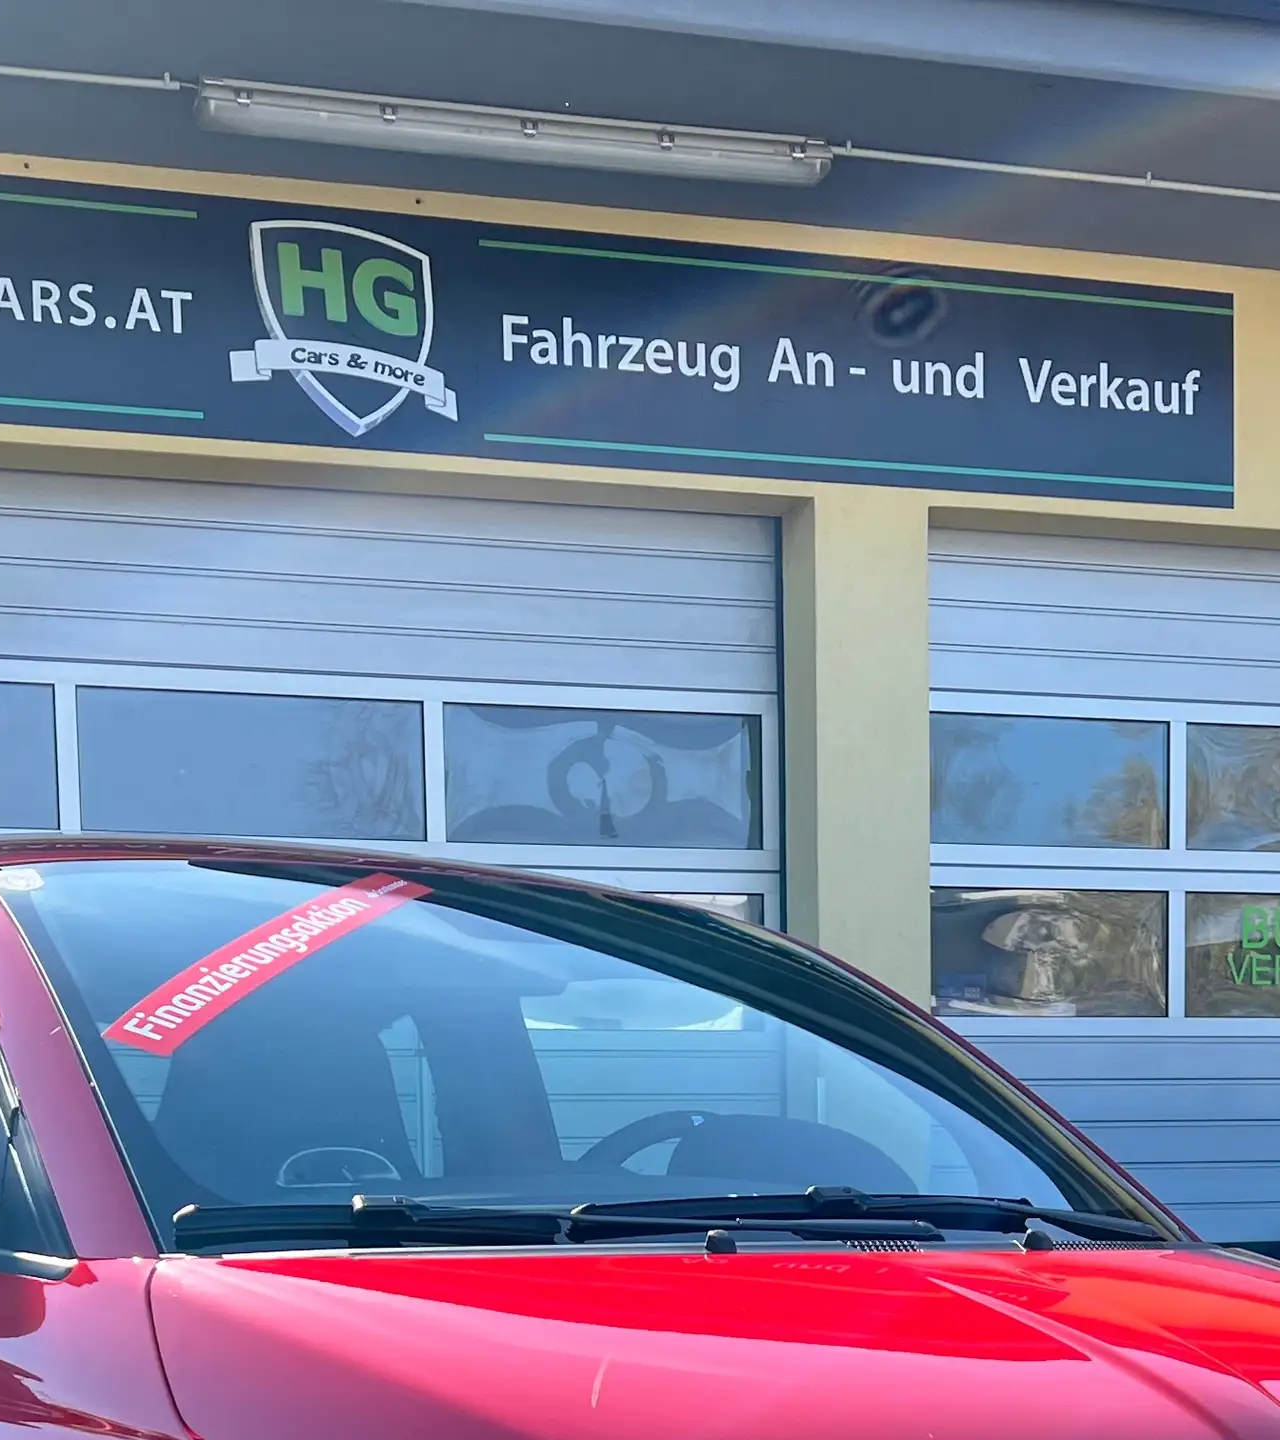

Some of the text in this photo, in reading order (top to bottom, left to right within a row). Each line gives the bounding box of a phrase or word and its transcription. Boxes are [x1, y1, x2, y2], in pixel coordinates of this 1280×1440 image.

[276, 241, 419, 337] HG
[290, 347, 426, 386] Cars & more
[502, 313, 740, 392] Fahrzeug
[892, 351, 985, 399] und
[1019, 358, 1200, 416] Verkauf
[123, 896, 371, 1041] Finanzierungsaktion
